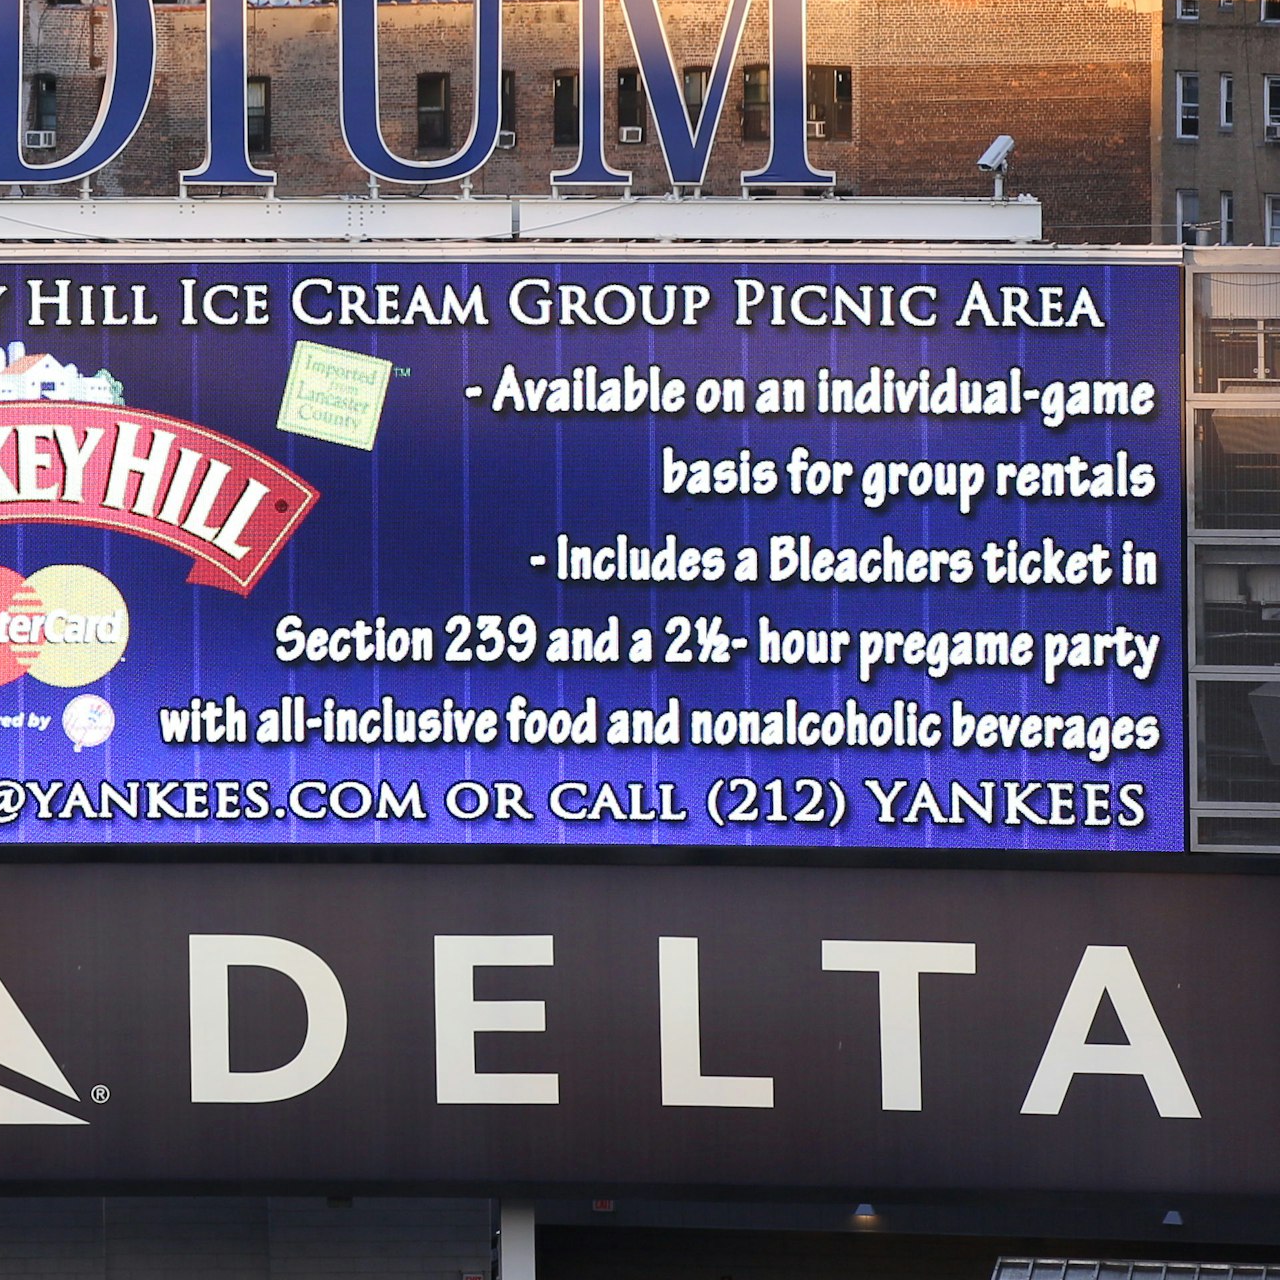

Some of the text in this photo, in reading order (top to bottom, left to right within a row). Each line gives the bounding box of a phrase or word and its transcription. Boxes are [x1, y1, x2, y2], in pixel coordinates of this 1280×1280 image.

[27, 279, 157, 326] HILL
[181, 279, 269, 325] ICE
[292, 279, 489, 325] CREAM
[509, 279, 710, 325] GROUP
[734, 279, 937, 326] PICNIC
[955, 280, 1105, 327] AREA
[305, 355, 377, 385] Imported
[492, 364, 685, 413] Available
[696, 379, 745, 413] on
[755, 379, 805, 413] an
[818, 366, 1155, 427] individual-game
[298, 380, 370, 413] Lancaster
[299, 404, 362, 429] County
[102, 422, 272, 562] HILL
[663, 446, 1156, 514] basis for group rentals
[557, 534, 725, 581] Includes
[734, 547, 758, 581] a
[769, 535, 974, 583] Bleachers
[982, 537, 1112, 585] ticket
[1122, 540, 1157, 585] in
[276, 615, 433, 662] Section
[445, 614, 537, 662] 239
[546, 616, 619, 663] and
[629, 628, 652, 663] a
[759, 616, 850, 664] hour
[859, 630, 1034, 682] pregame
[1045, 626, 1160, 684] party
[28, 711, 52, 732] by
[160, 696, 246, 742] with
[256, 696, 497, 743] all-inclusive
[506, 695, 597, 744] food
[607, 698, 680, 745] and
[691, 699, 942, 747] nonalcoholic
[953, 700, 1160, 762] beverages
[446, 782, 533, 819] OR
[550, 782, 686, 820] CALL
[708, 778, 845, 827] (212)
[865, 780, 1144, 826] YANKEES
[189, 933, 1202, 1119] DELTA
